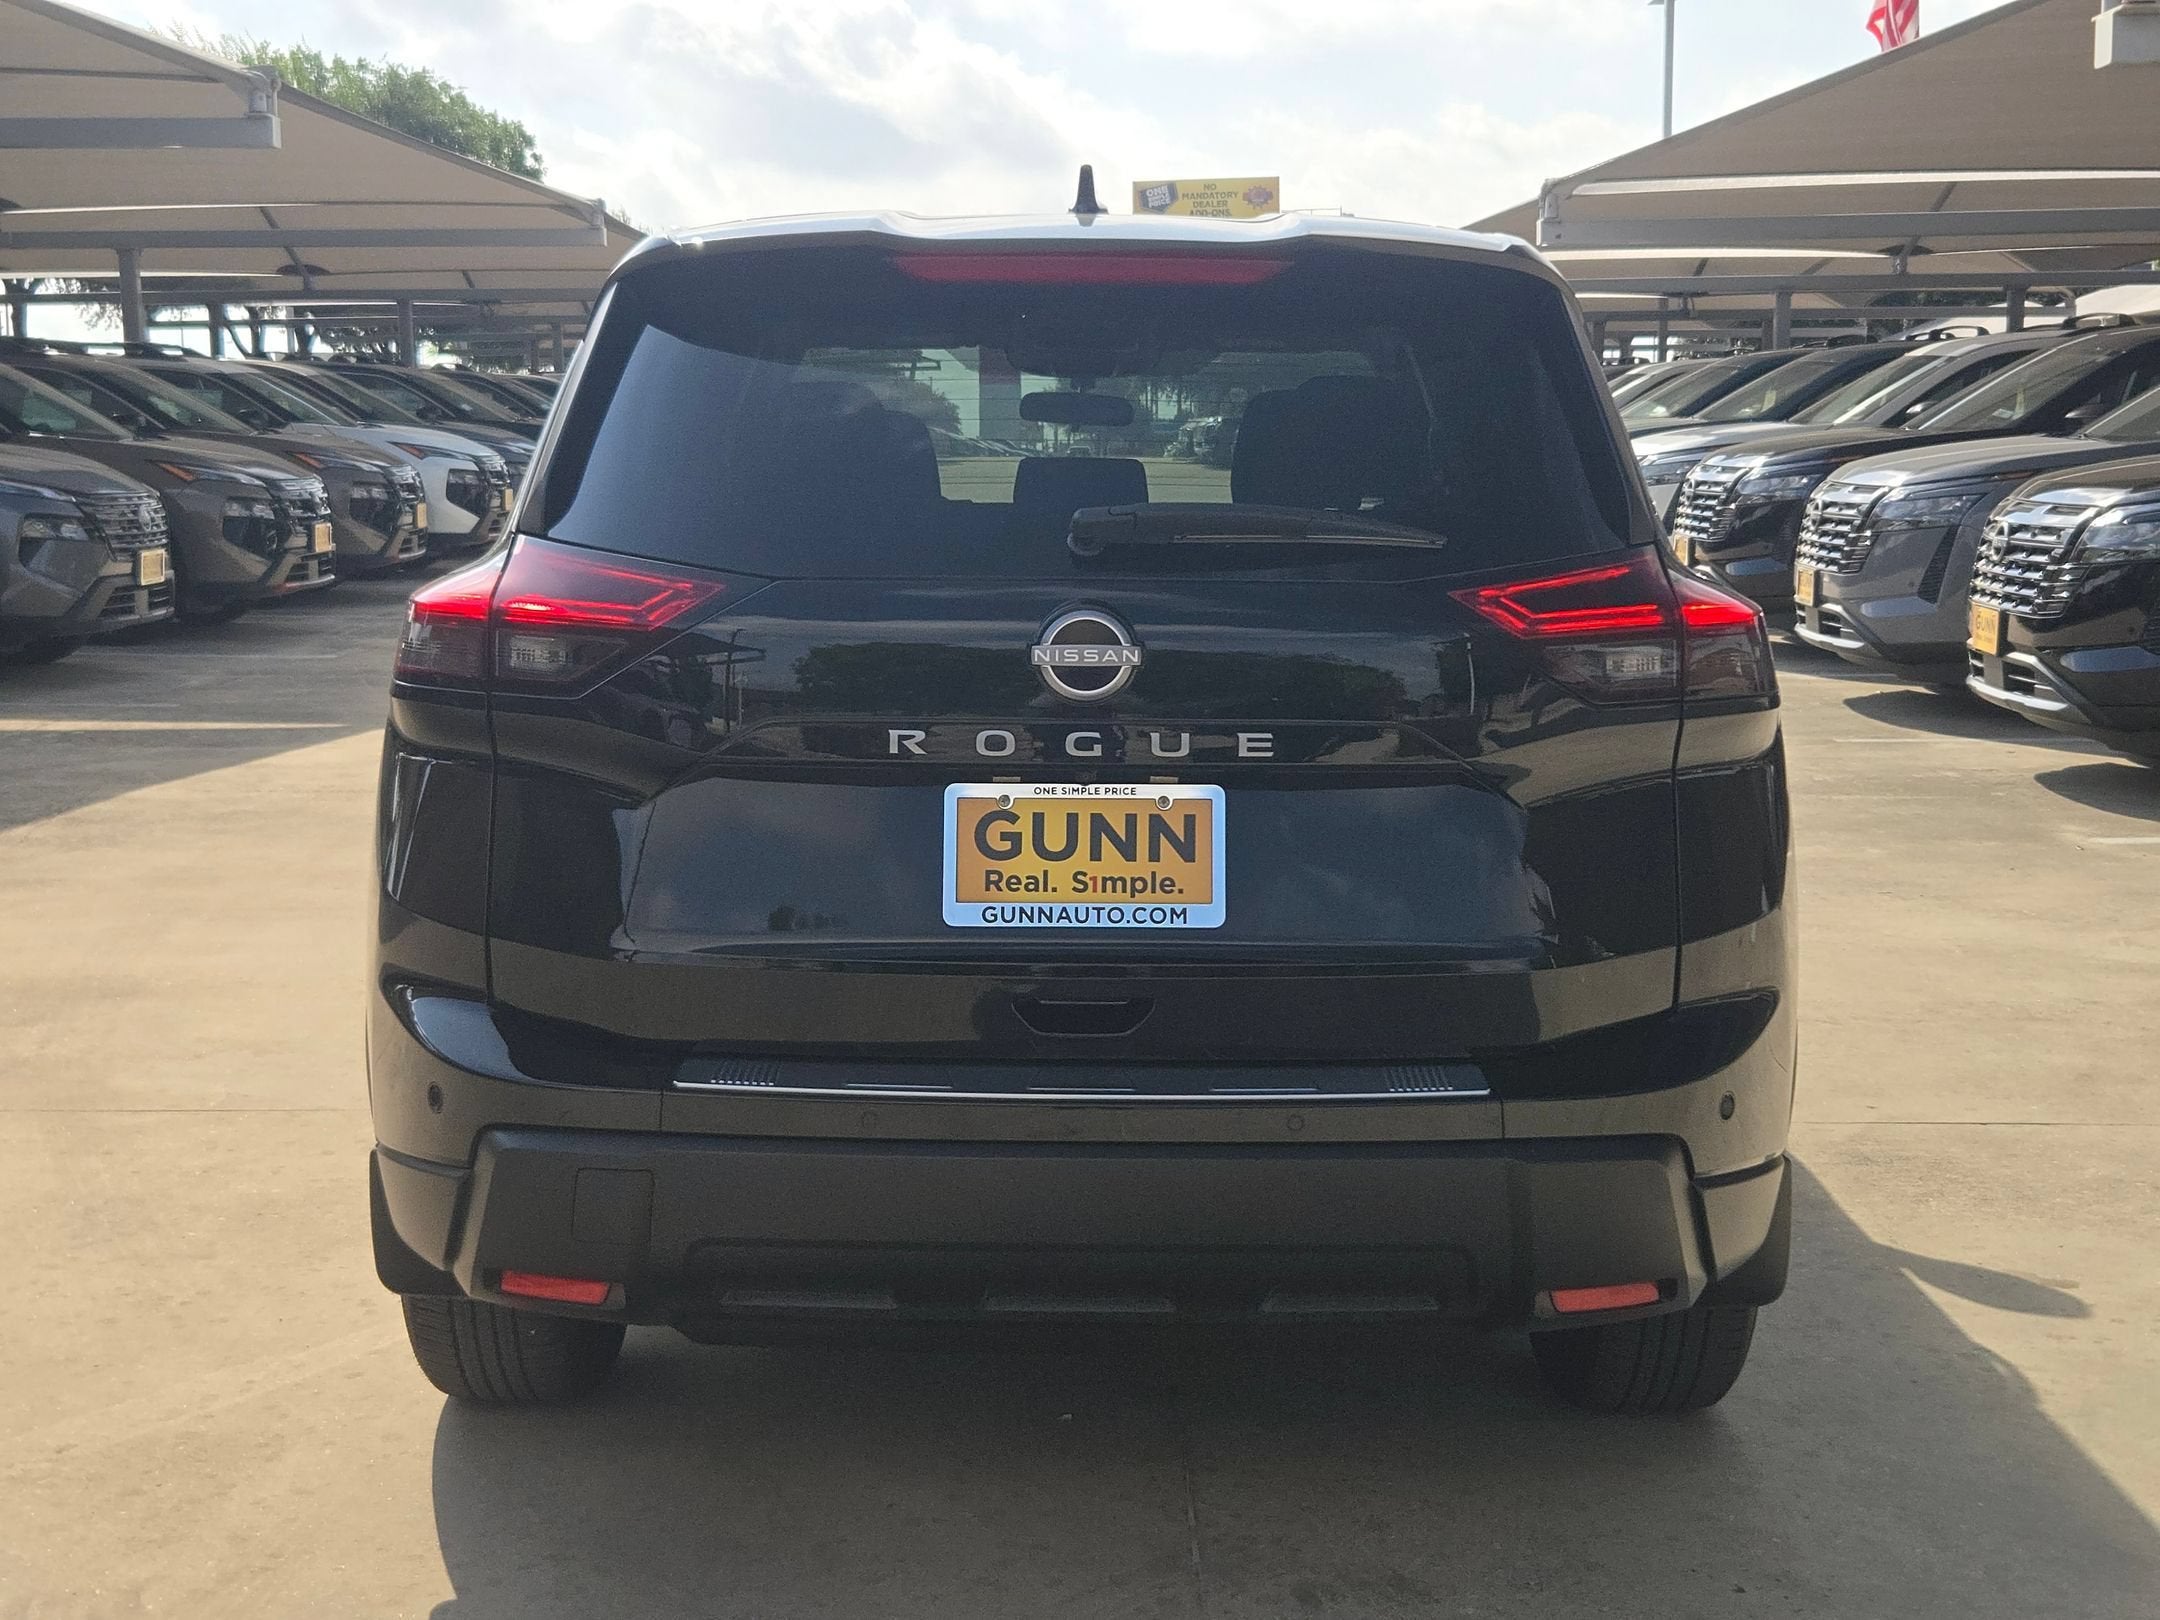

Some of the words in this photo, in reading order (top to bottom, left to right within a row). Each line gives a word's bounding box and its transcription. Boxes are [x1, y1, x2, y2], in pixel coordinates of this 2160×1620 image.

[1146, 185, 1168, 197] ONE
[1182, 191, 1239, 200] MANDATORY
[1193, 200, 1228, 208] DEALER
[1034, 648, 1139, 663] NISSAN
[888, 729, 1275, 758] ROGUE
[1034, 786, 1059, 796] ONE
[1061, 786, 1102, 796] SIMPLE
[1104, 786, 1137, 796] PRICE
[974, 809, 1197, 863] GUNN
[984, 869, 1058, 893] Real.
[981, 906, 1188, 925] GUNNAUTO.COM
